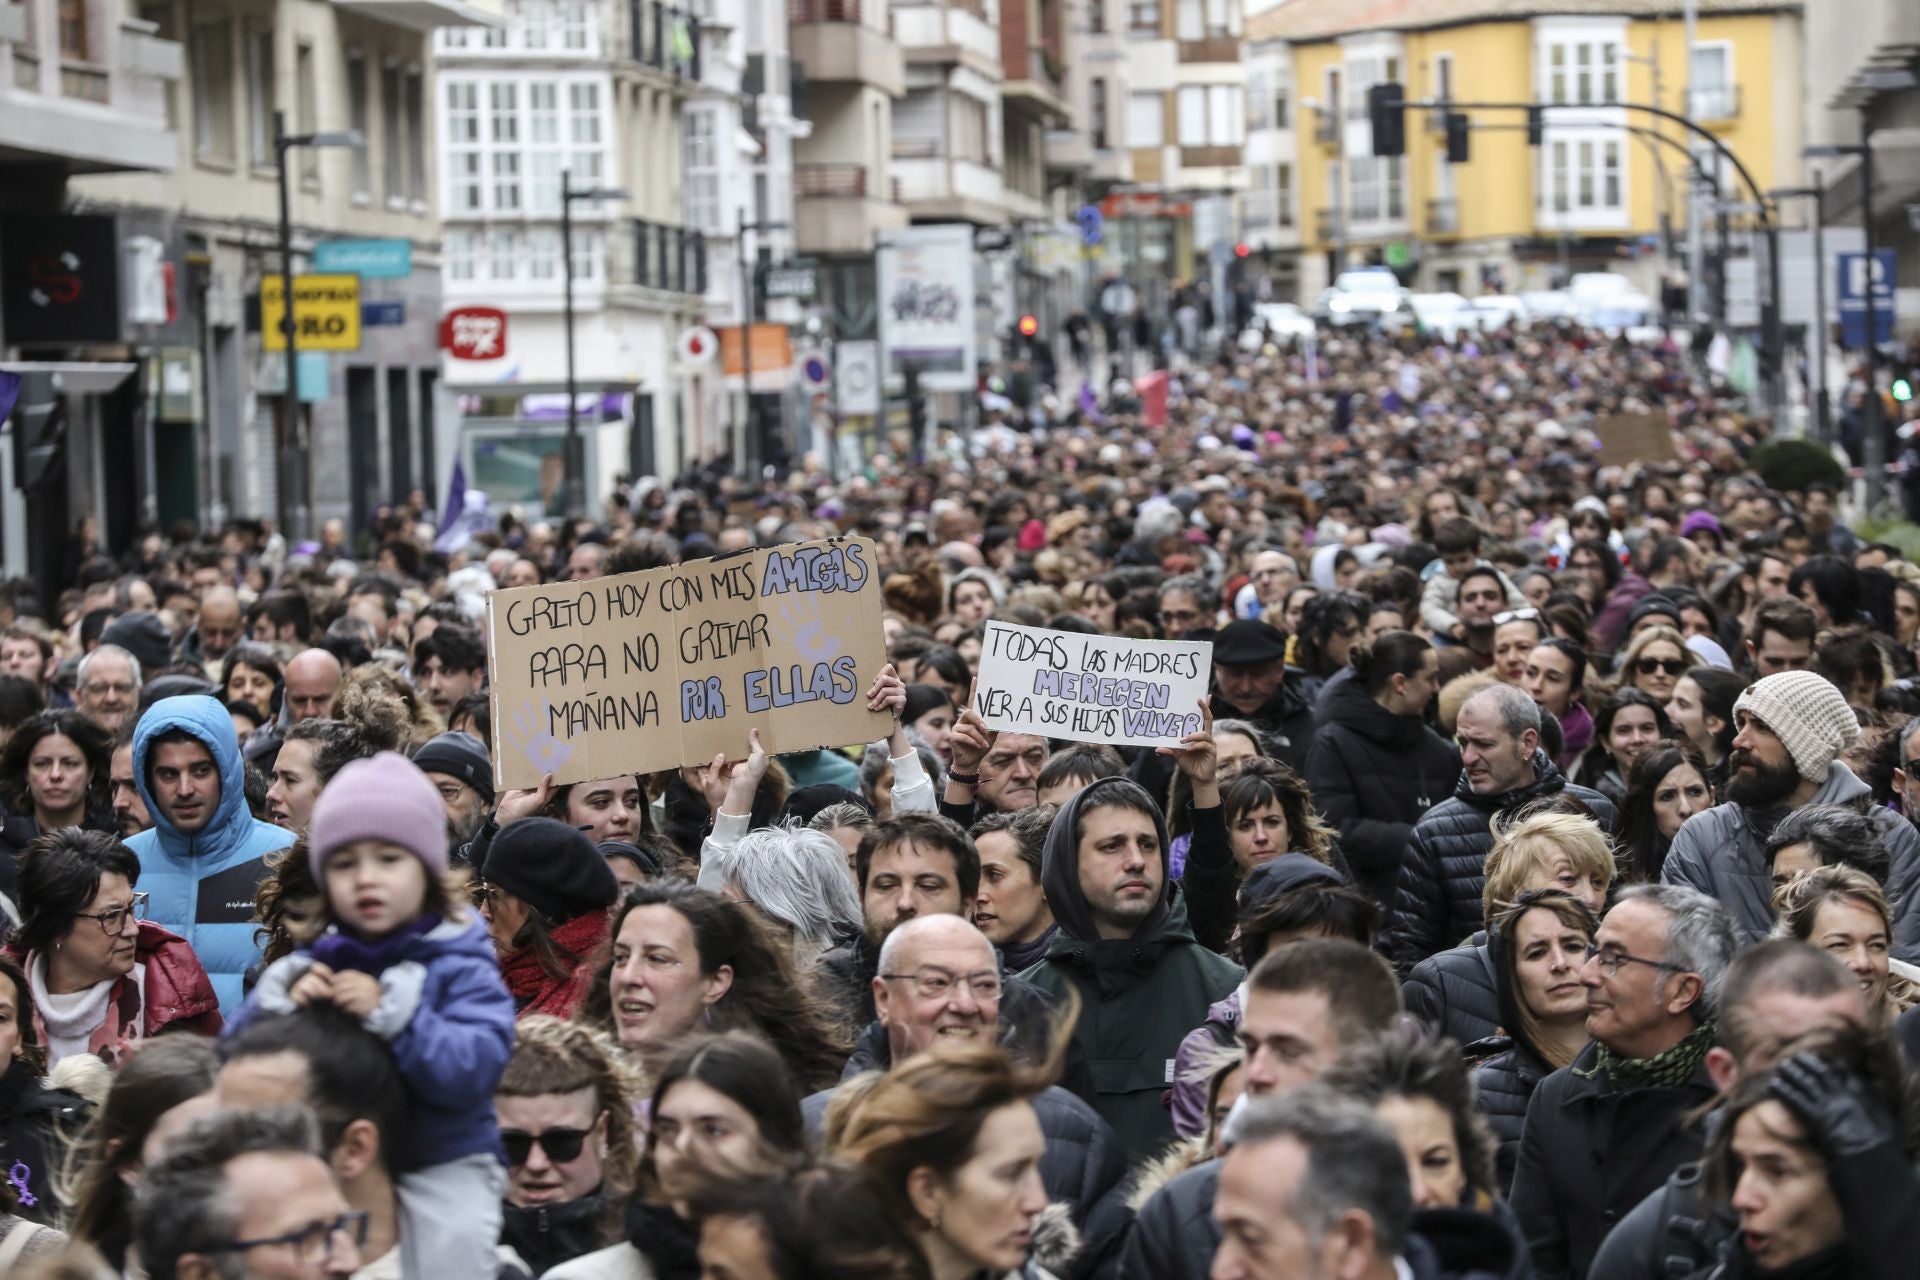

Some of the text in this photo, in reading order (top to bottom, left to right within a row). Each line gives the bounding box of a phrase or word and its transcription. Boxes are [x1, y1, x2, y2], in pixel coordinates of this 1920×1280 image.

[506, 543, 869, 636] GRITO HOY CON MIS AMIGAS
[529, 613, 771, 689] PARA NO GRITAR
[989, 627, 1201, 680] TODAS LAS MADRES
[549, 655, 858, 740] MAÑANA POR ELLAS
[977, 686, 1201, 738] VER A SUS HIJAS VOLVER
[1032, 668, 1171, 710] MERECEN
